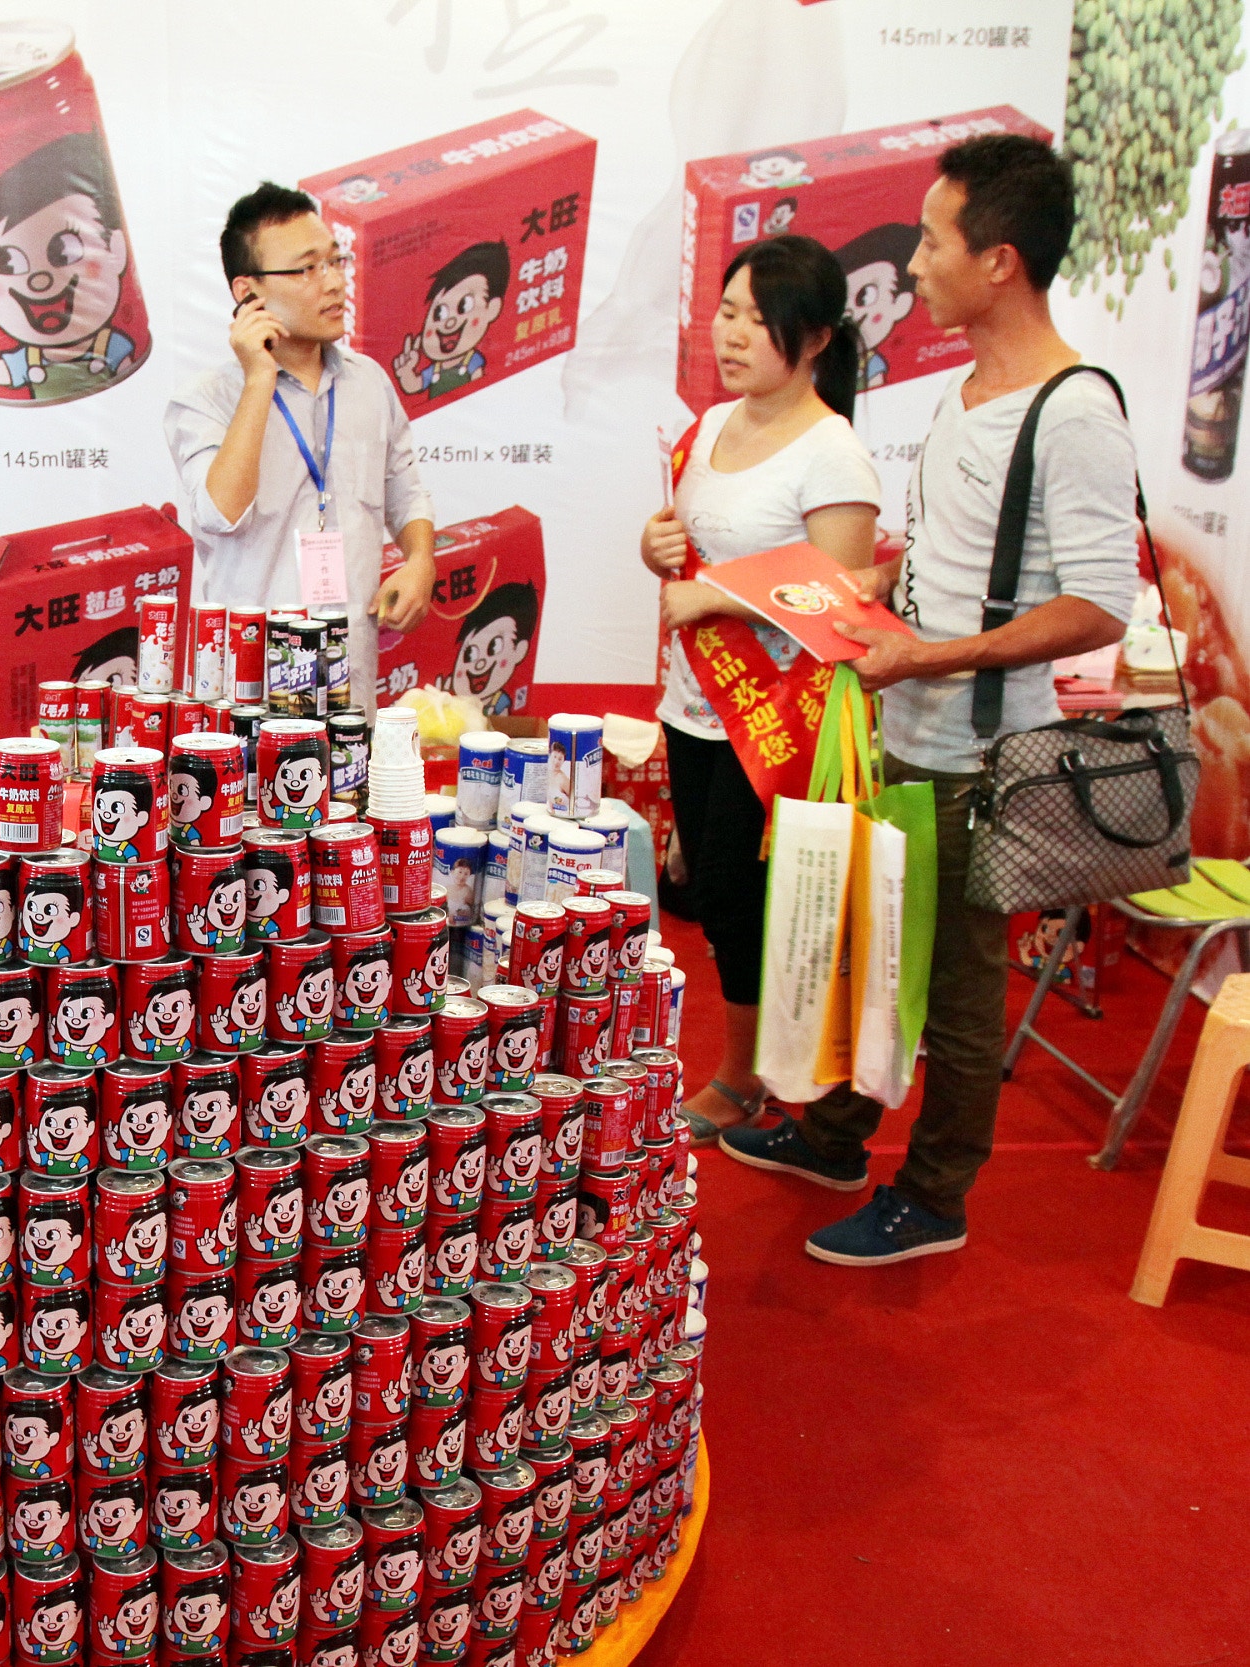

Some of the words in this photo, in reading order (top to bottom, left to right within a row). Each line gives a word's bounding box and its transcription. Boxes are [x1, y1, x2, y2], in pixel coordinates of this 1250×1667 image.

[879, 29, 942, 48] 145ml
[962, 27, 1032, 48] 20罐装
[440, 119, 567, 166] 牛奶饮料
[520, 192, 580, 243] 大旺
[518, 246, 568, 284] 牛奶
[516, 274, 564, 315] 饮料
[3, 447, 109, 471] 145ml罐装
[418, 445, 478, 464] 245ml
[501, 443, 554, 464] 9罐装
[67, 542, 150, 566] 牛奶饮料
[134, 565, 181, 592] 牛奶
[14, 593, 81, 637] 大旺
[85, 585, 126, 614] 精品
[148, 610, 168, 621] 大旺
[206, 617, 224, 628] 大旺
[0, 763, 40, 782] 大旺
[0, 787, 40, 802] 牛奶饮料
[6, 803, 34, 814] 复原乳
[410, 828, 430, 844] 精品
[351, 845, 374, 863] 精品
[408, 850, 431, 859] MILK
[557, 856, 576, 868] 大旺
[351, 868, 377, 879] MILK
[351, 877, 377, 886] DRINK
